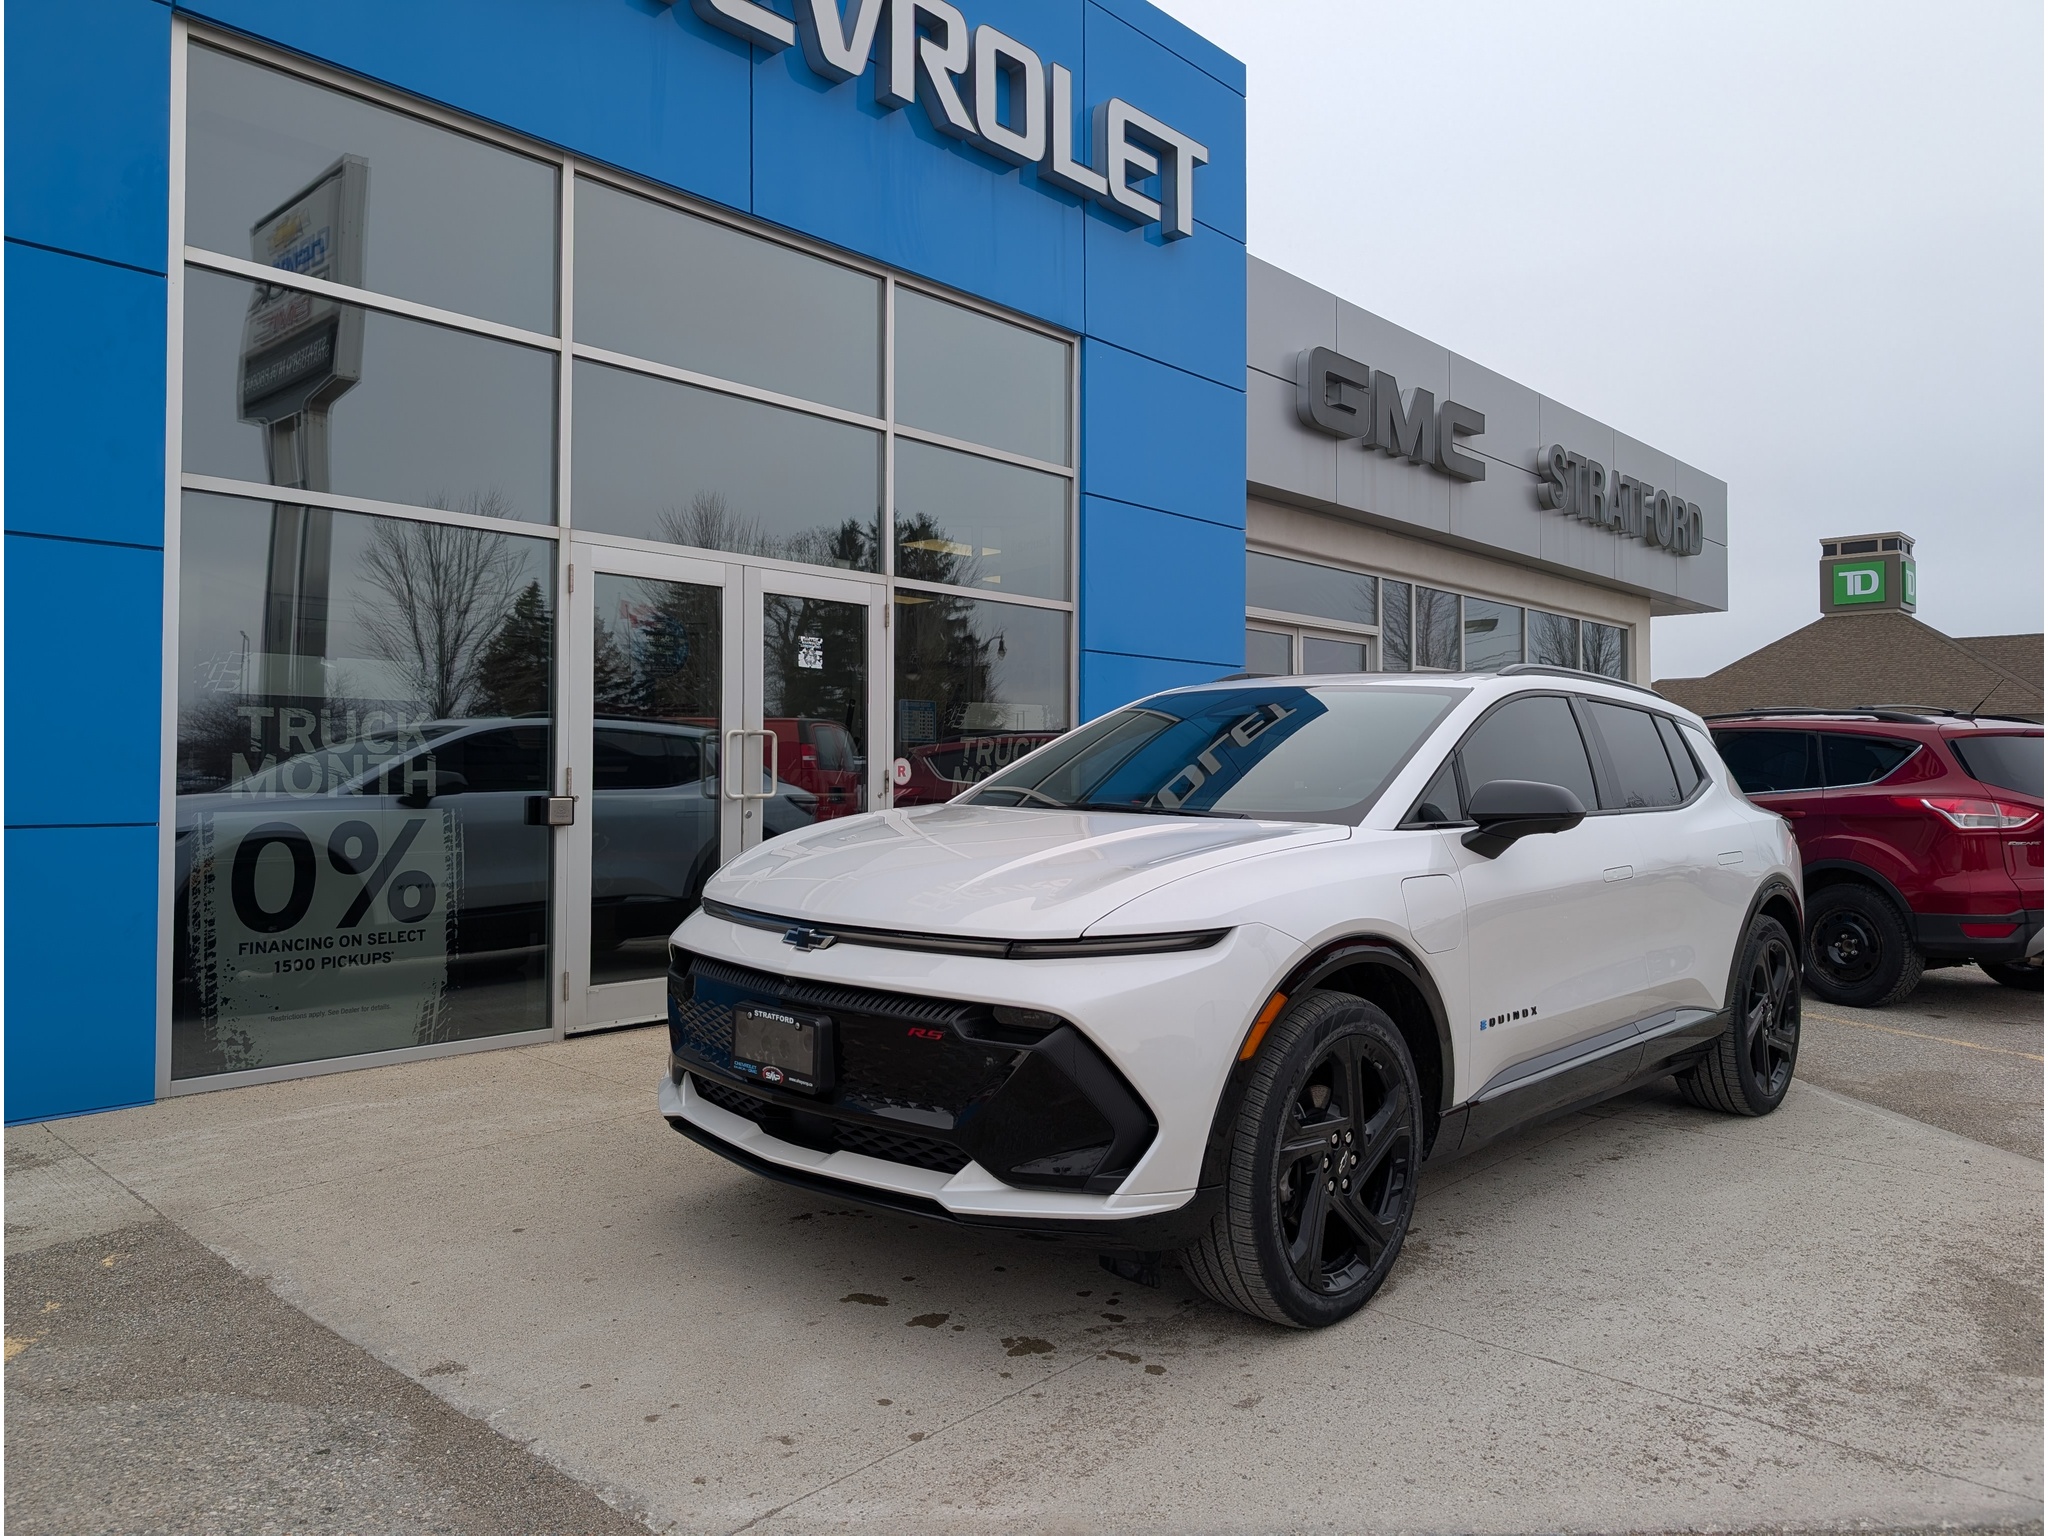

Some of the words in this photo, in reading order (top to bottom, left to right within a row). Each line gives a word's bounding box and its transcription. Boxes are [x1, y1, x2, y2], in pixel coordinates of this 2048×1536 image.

[1296, 345, 1486, 481] GMC
[1537, 443, 1704, 556] STRATFORD
[1838, 569, 1879, 596] TD
[237, 707, 433, 754] TRUCK
[231, 752, 437, 799] MONTH
[897, 766, 906, 777] R
[231, 819, 437, 934] 0%
[238, 936, 334, 956] FINANCING
[339, 934, 362, 948] ON
[367, 929, 426, 946] SELECT
[274, 957, 315, 974] 1500
[328, 1007, 340, 1016] See
[341, 1005, 360, 1015] Dealer
[361, 1004, 369, 1012] for
[370, 1003, 392, 1012] details.
[754, 1010, 794, 1024] STRATFORD
[1480, 1006, 1537, 1031] EQUINOX
[908, 1027, 943, 1039] RS
